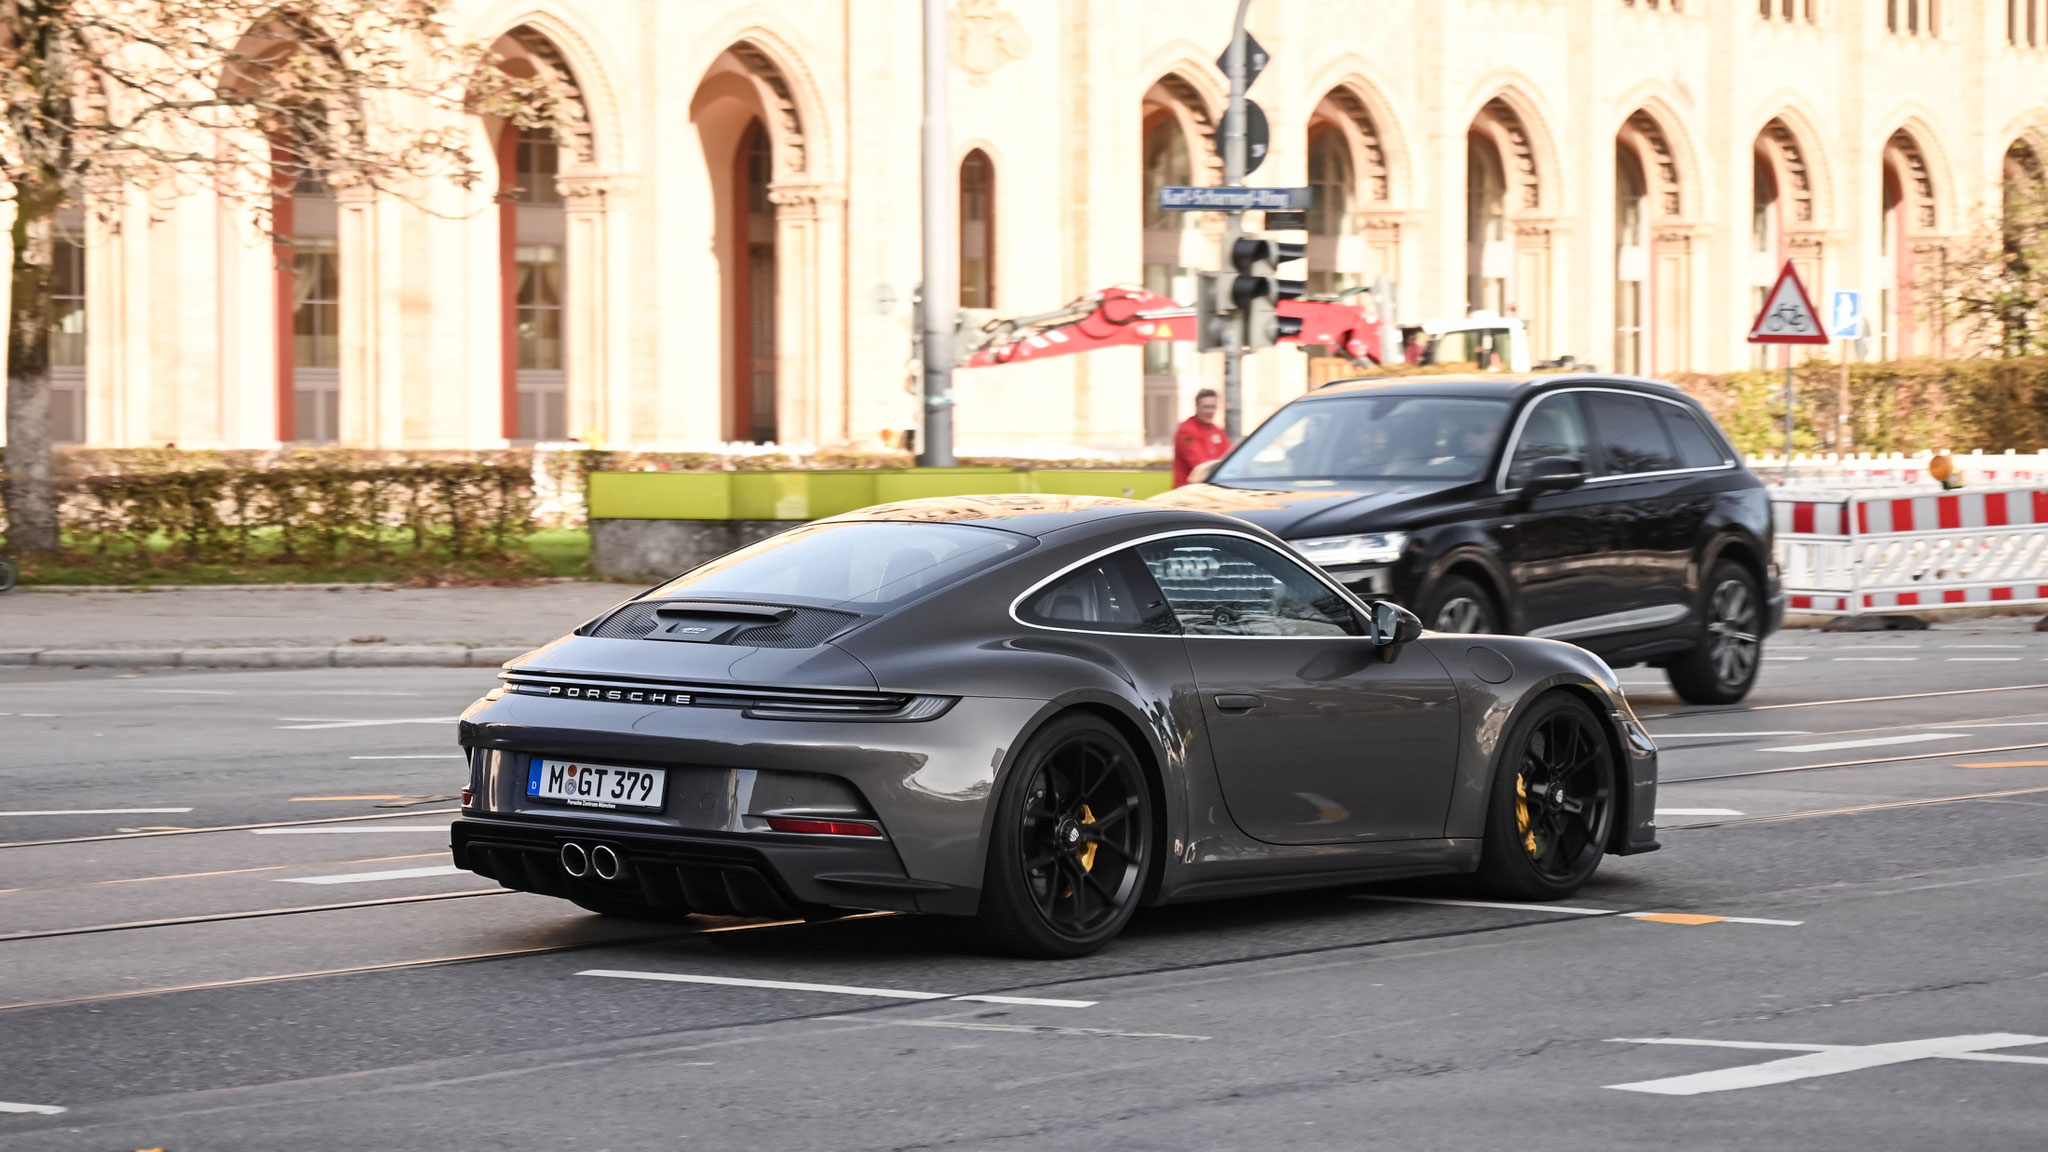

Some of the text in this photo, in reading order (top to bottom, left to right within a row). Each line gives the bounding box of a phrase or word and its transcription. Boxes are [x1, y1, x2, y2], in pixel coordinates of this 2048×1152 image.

[549, 686, 691, 704] PORSCHE
[531, 781, 537, 790] D
[548, 765, 654, 802] M GT 379
